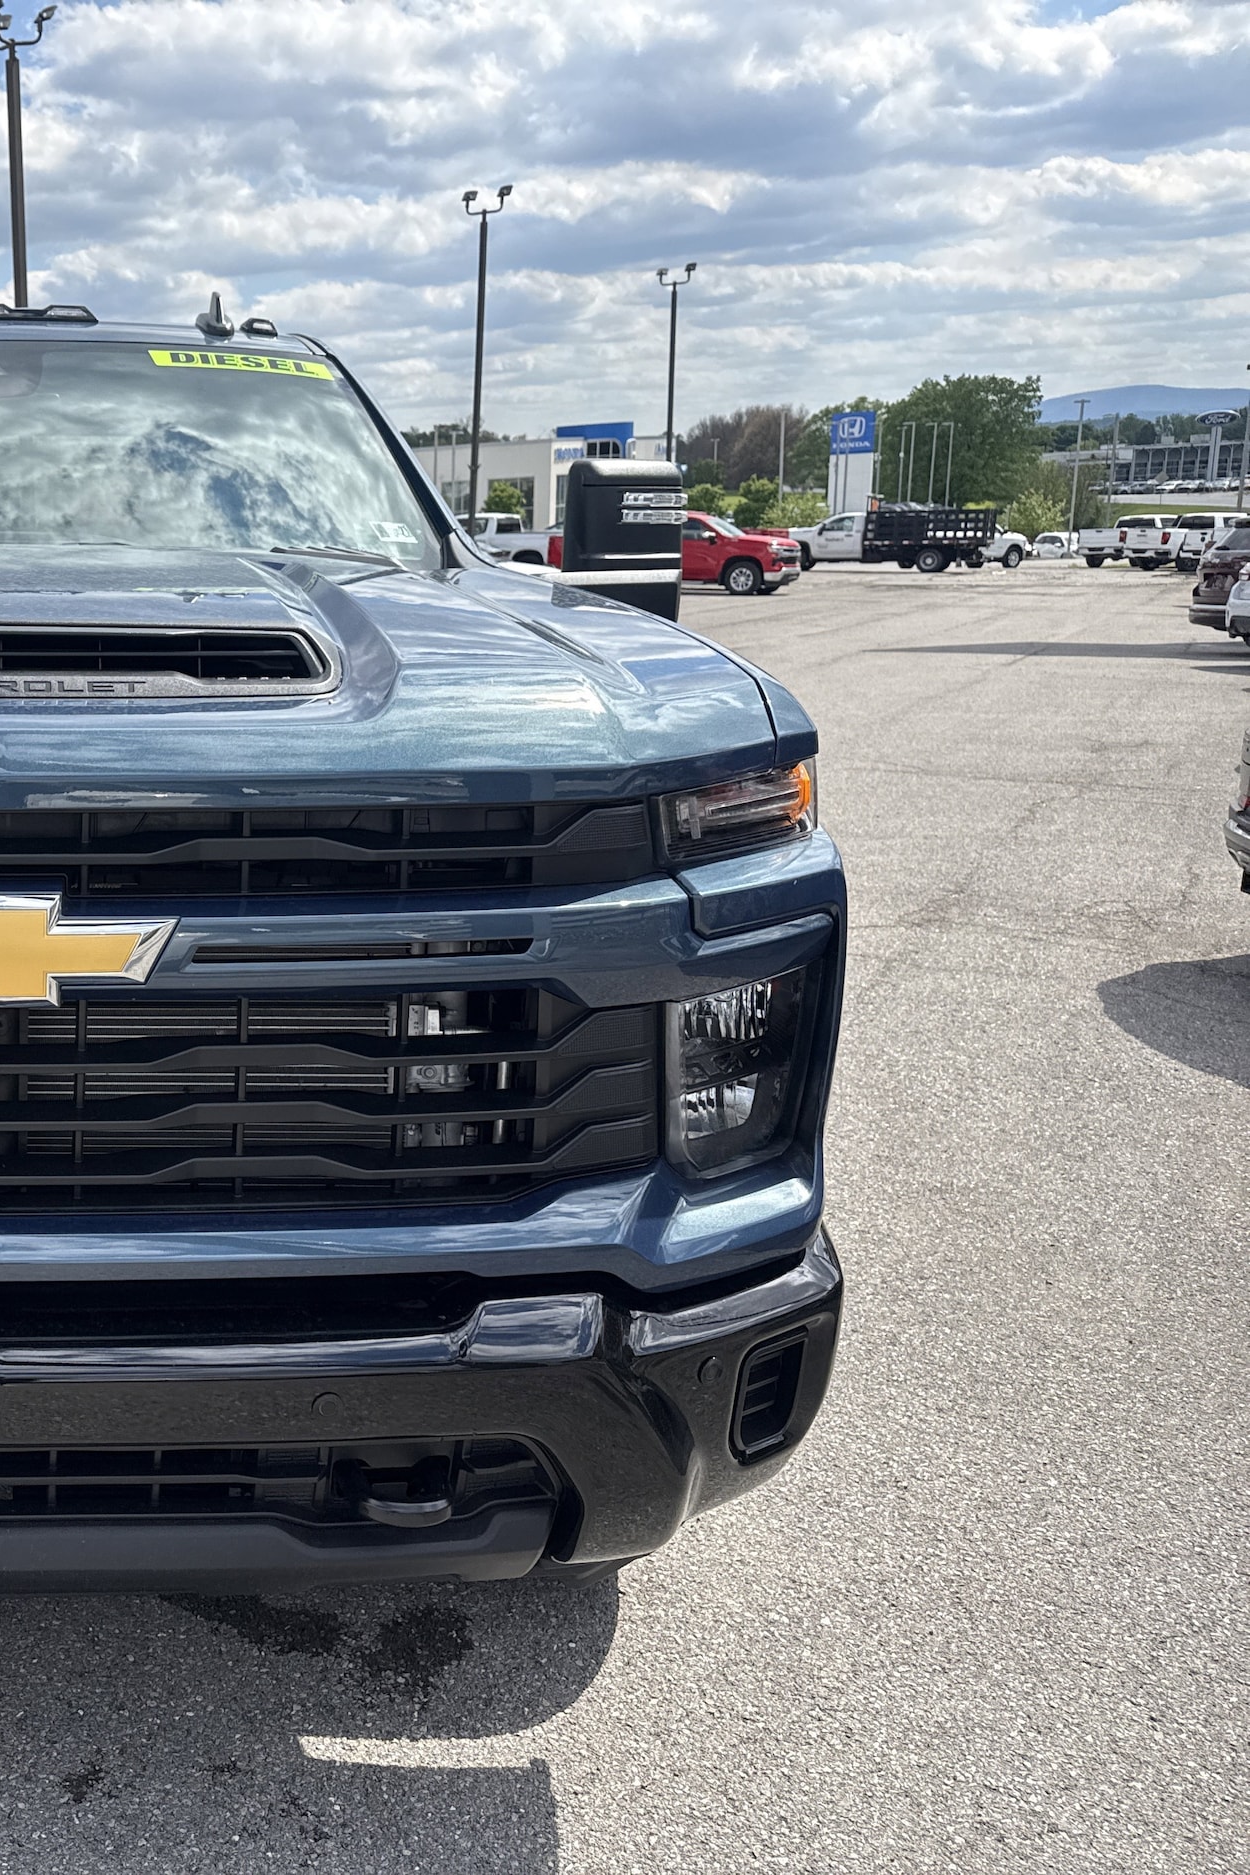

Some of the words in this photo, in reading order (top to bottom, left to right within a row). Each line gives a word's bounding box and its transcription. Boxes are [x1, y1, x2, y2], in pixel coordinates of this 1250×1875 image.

[170, 352, 319, 376] DIESEL
[1205, 413, 1232, 425] Ford
[832, 441, 871, 449] HONDA
